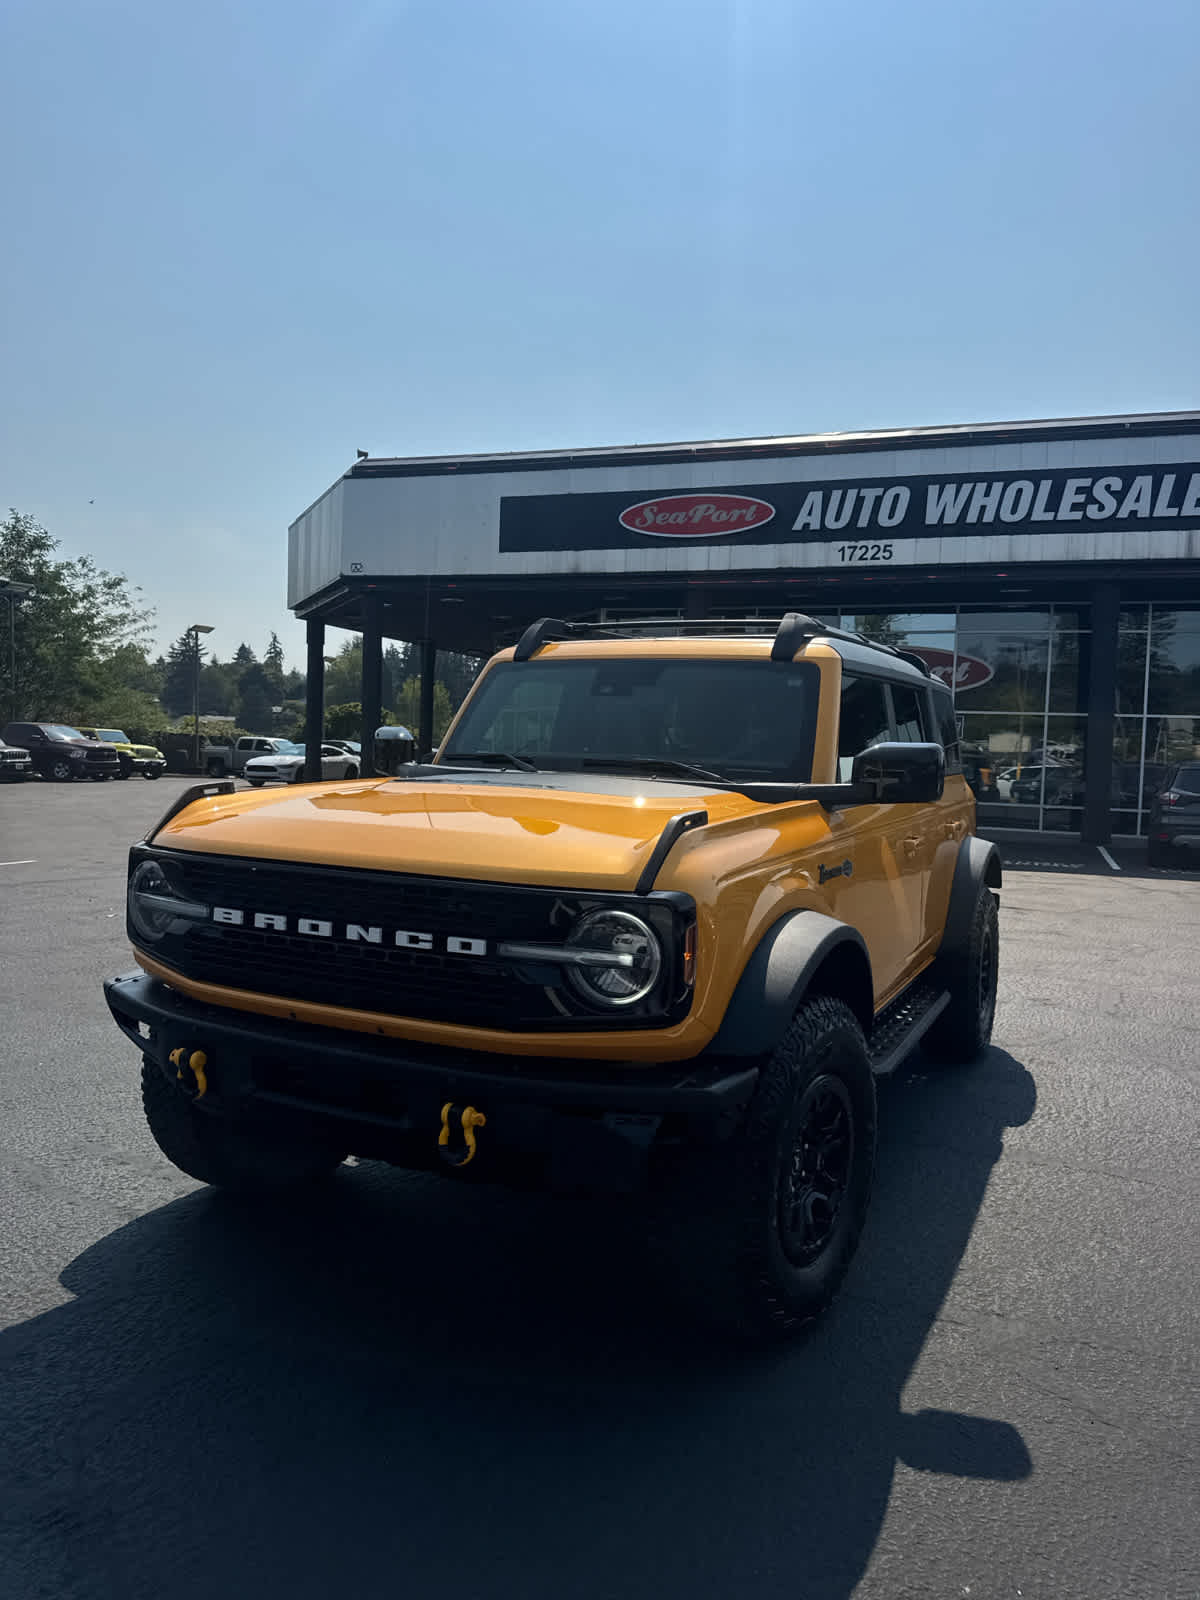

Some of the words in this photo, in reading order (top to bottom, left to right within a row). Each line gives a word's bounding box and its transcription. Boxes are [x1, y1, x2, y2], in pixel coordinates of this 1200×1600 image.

[635, 503, 757, 527] SeaPort
[792, 486, 911, 531] AUTO
[838, 544, 893, 562] 17225
[213, 907, 487, 955] BRONCO
